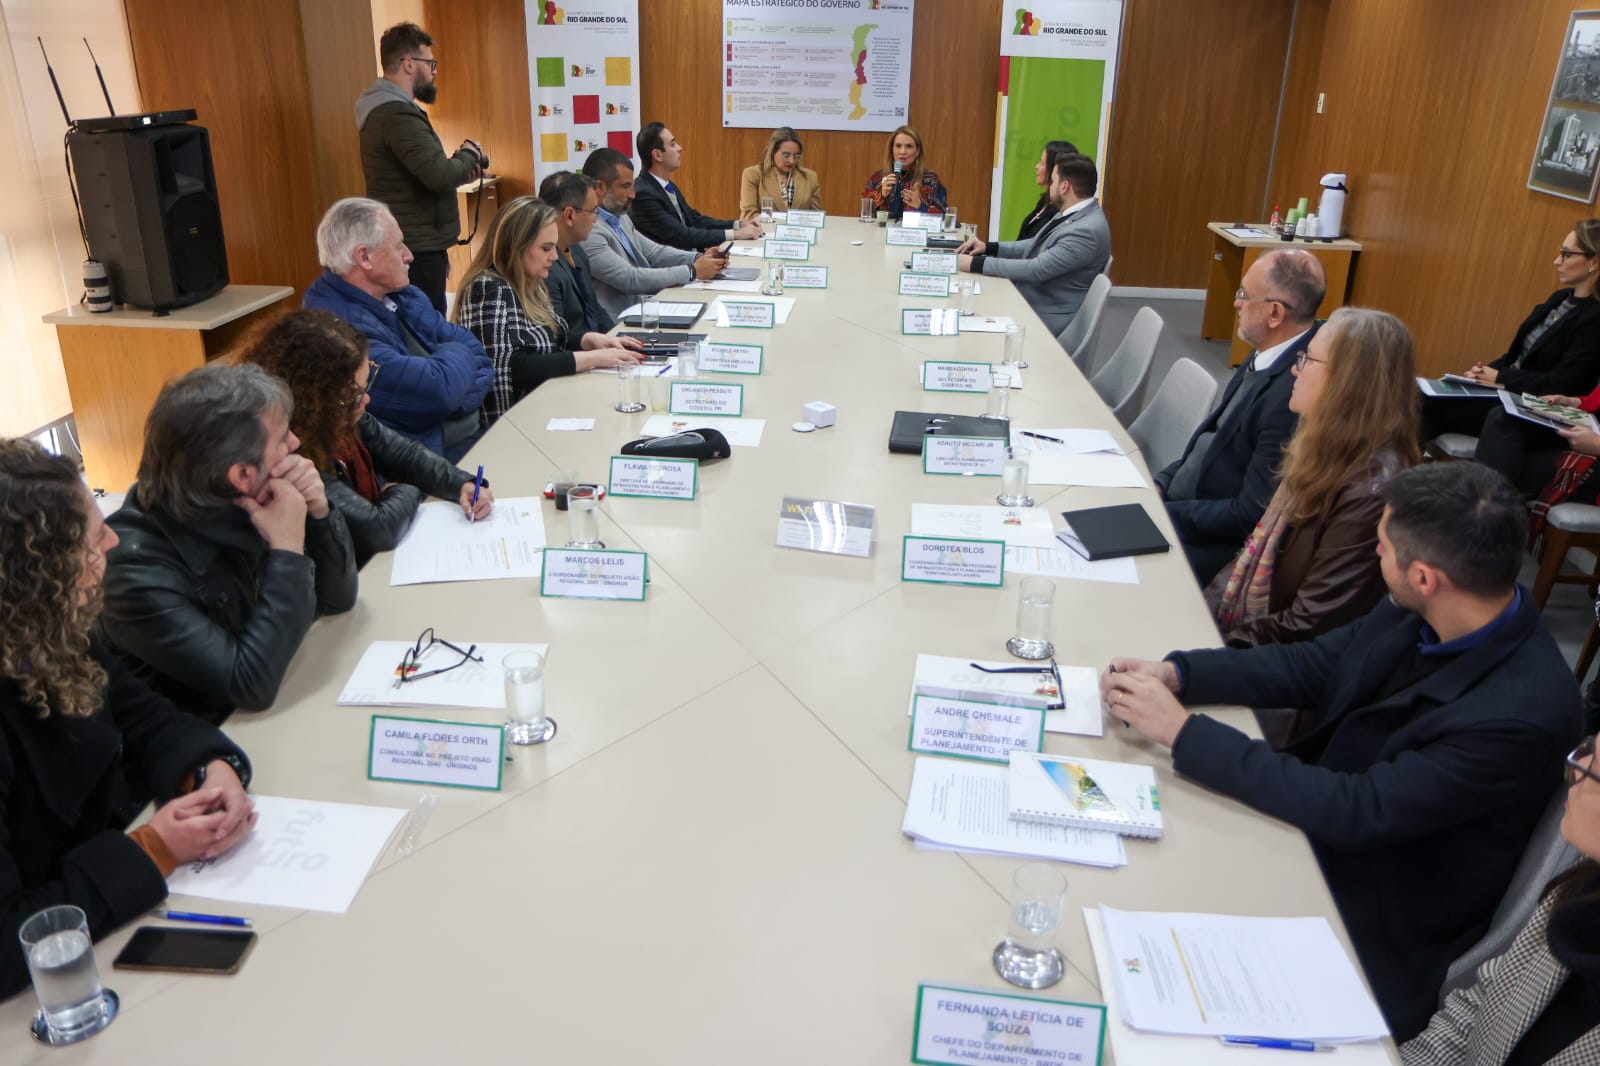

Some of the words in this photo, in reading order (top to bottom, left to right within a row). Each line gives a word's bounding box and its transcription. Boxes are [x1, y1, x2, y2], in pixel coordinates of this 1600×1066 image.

[820, 0, 860, 8] GOVERNO
[923, 544, 961, 553] DOROTEA
[963, 545, 984, 554] BLOS
[565, 556, 600, 564] MARCOS
[972, 711, 1022, 724] CHEMALE
[385, 729, 420, 740] CAMILA
[422, 733, 460, 743] FLORES
[462, 735, 488, 746] ORTH
[924, 728, 1012, 745] SUPERINTENDENTE
[1015, 739, 1028, 747] DE
[920, 738, 995, 754] PLANEJAMENTO
[380, 748, 423, 758] CONSULTORA
[439, 753, 470, 761] PROJETO
[471, 755, 492, 764] VISÃO
[392, 758, 425, 766] REGIONAL
[446, 762, 478, 770] UNISINOS
[937, 1000, 1009, 1018] FERNANDA
[1012, 1011, 1062, 1025] LETÍCIA
[1066, 1017, 1084, 1027] DE
[986, 1022, 1031, 1036] SOUZA
[932, 1035, 964, 1046] CHEFE
[967, 1039, 982, 1048] DO
[984, 1041, 1066, 1059] DEPARTAMENTO
[1069, 1052, 1082, 1061] DE
[948, 1049, 1028, 1065] PLANEJAMENTO
